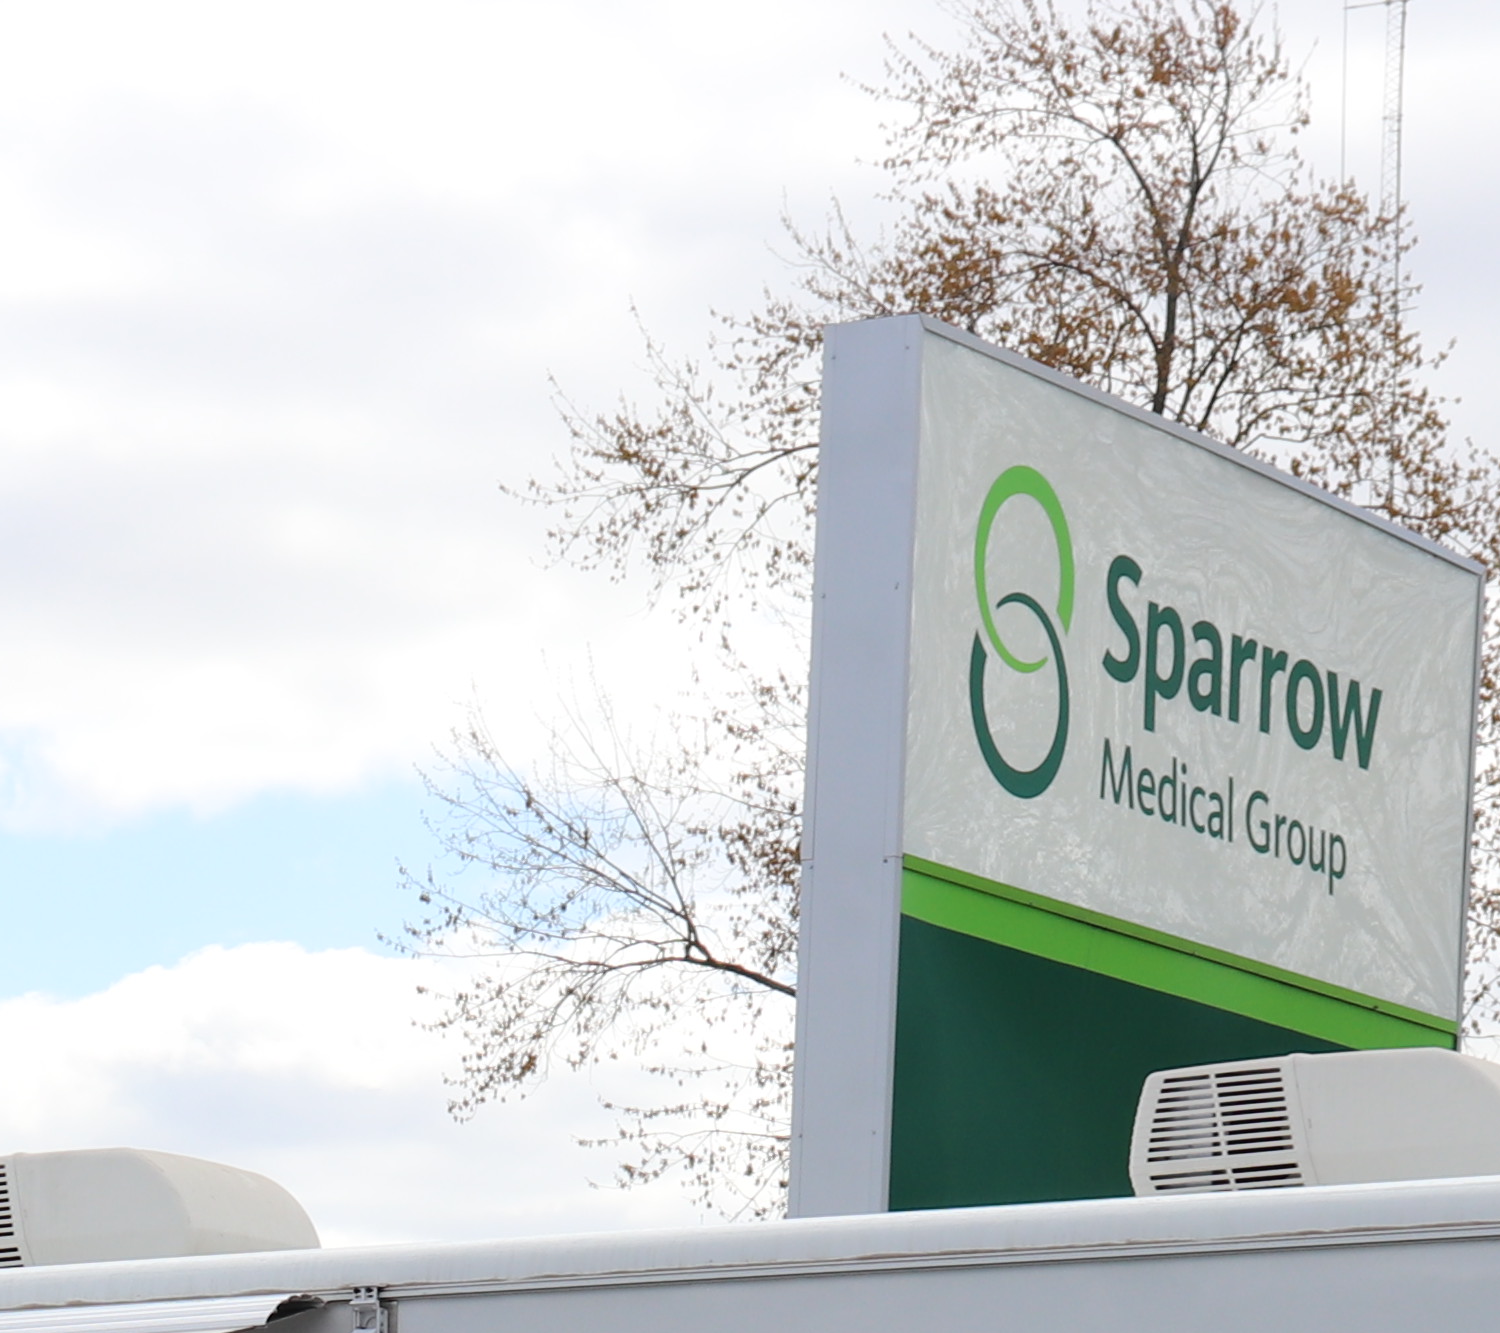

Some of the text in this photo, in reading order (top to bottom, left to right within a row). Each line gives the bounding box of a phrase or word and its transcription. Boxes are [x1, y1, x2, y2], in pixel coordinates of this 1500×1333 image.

[1102, 555, 1382, 770] Sparrow
[1100, 737, 1347, 896] Medical Group
